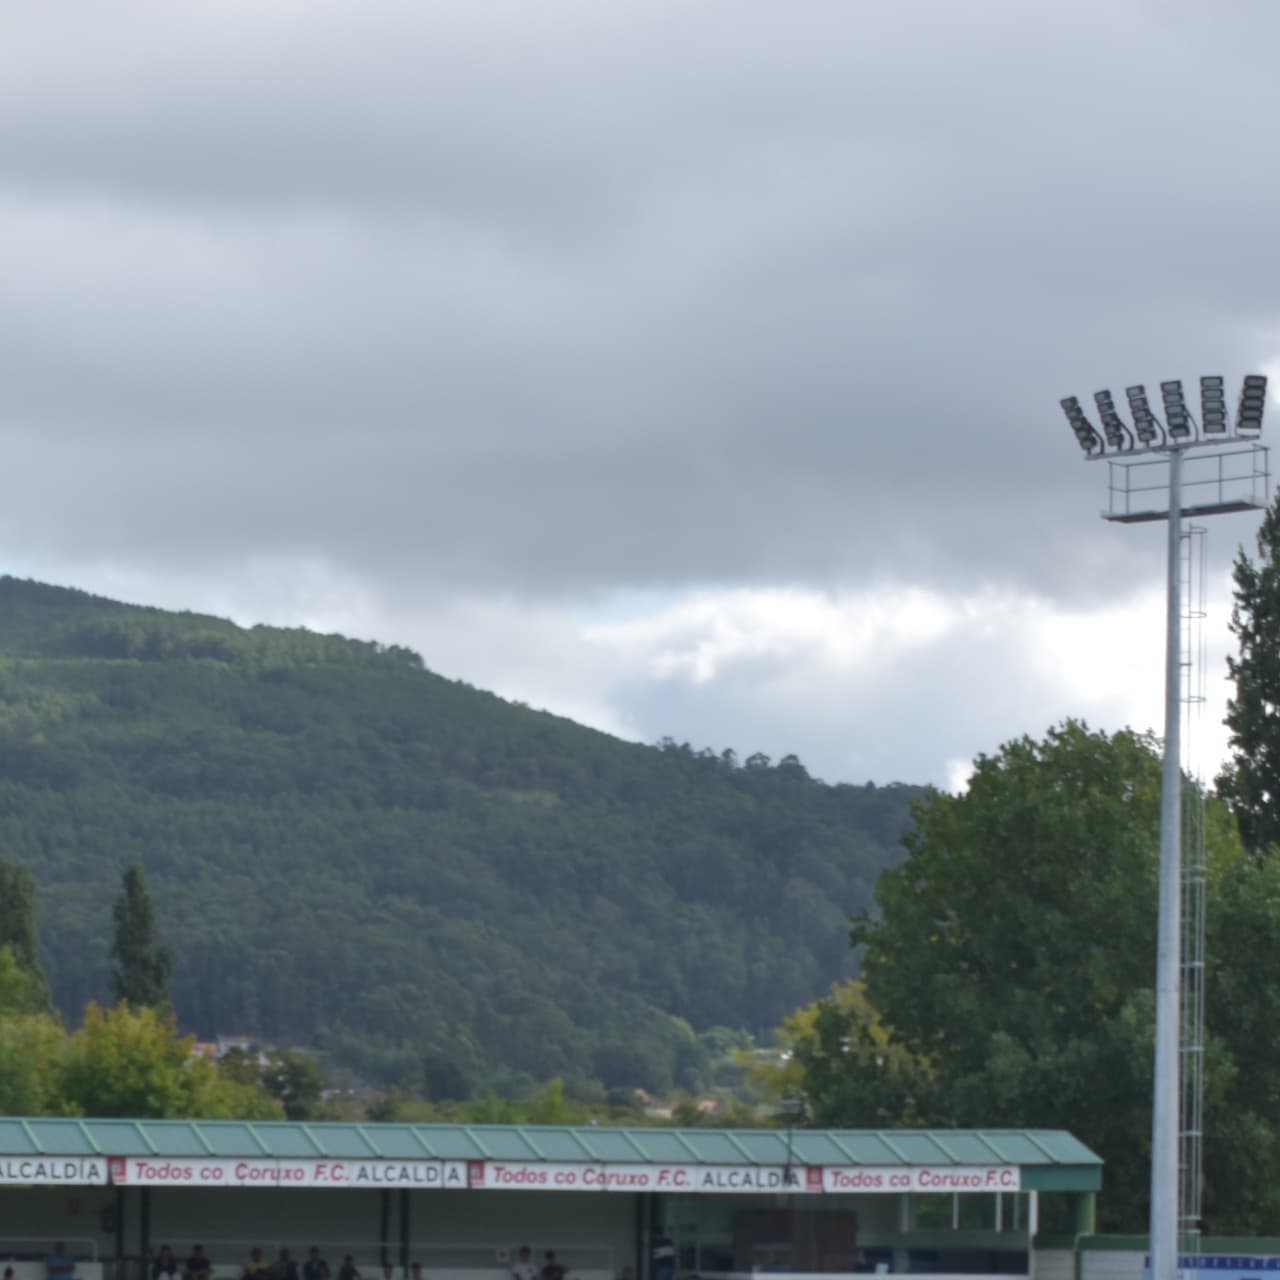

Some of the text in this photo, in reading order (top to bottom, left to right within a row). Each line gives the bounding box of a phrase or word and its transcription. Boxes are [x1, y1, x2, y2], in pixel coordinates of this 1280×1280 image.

[135, 1162, 196, 1181] Todos
[200, 1167, 224, 1182] co
[234, 1163, 305, 1183] Coruxo
[314, 1164, 350, 1183] F.C.
[493, 1166, 801, 1188] Todos co Coruxo F.C. ALCALDA
[831, 1170, 1018, 1188] Todos co Coruxo F.C.
